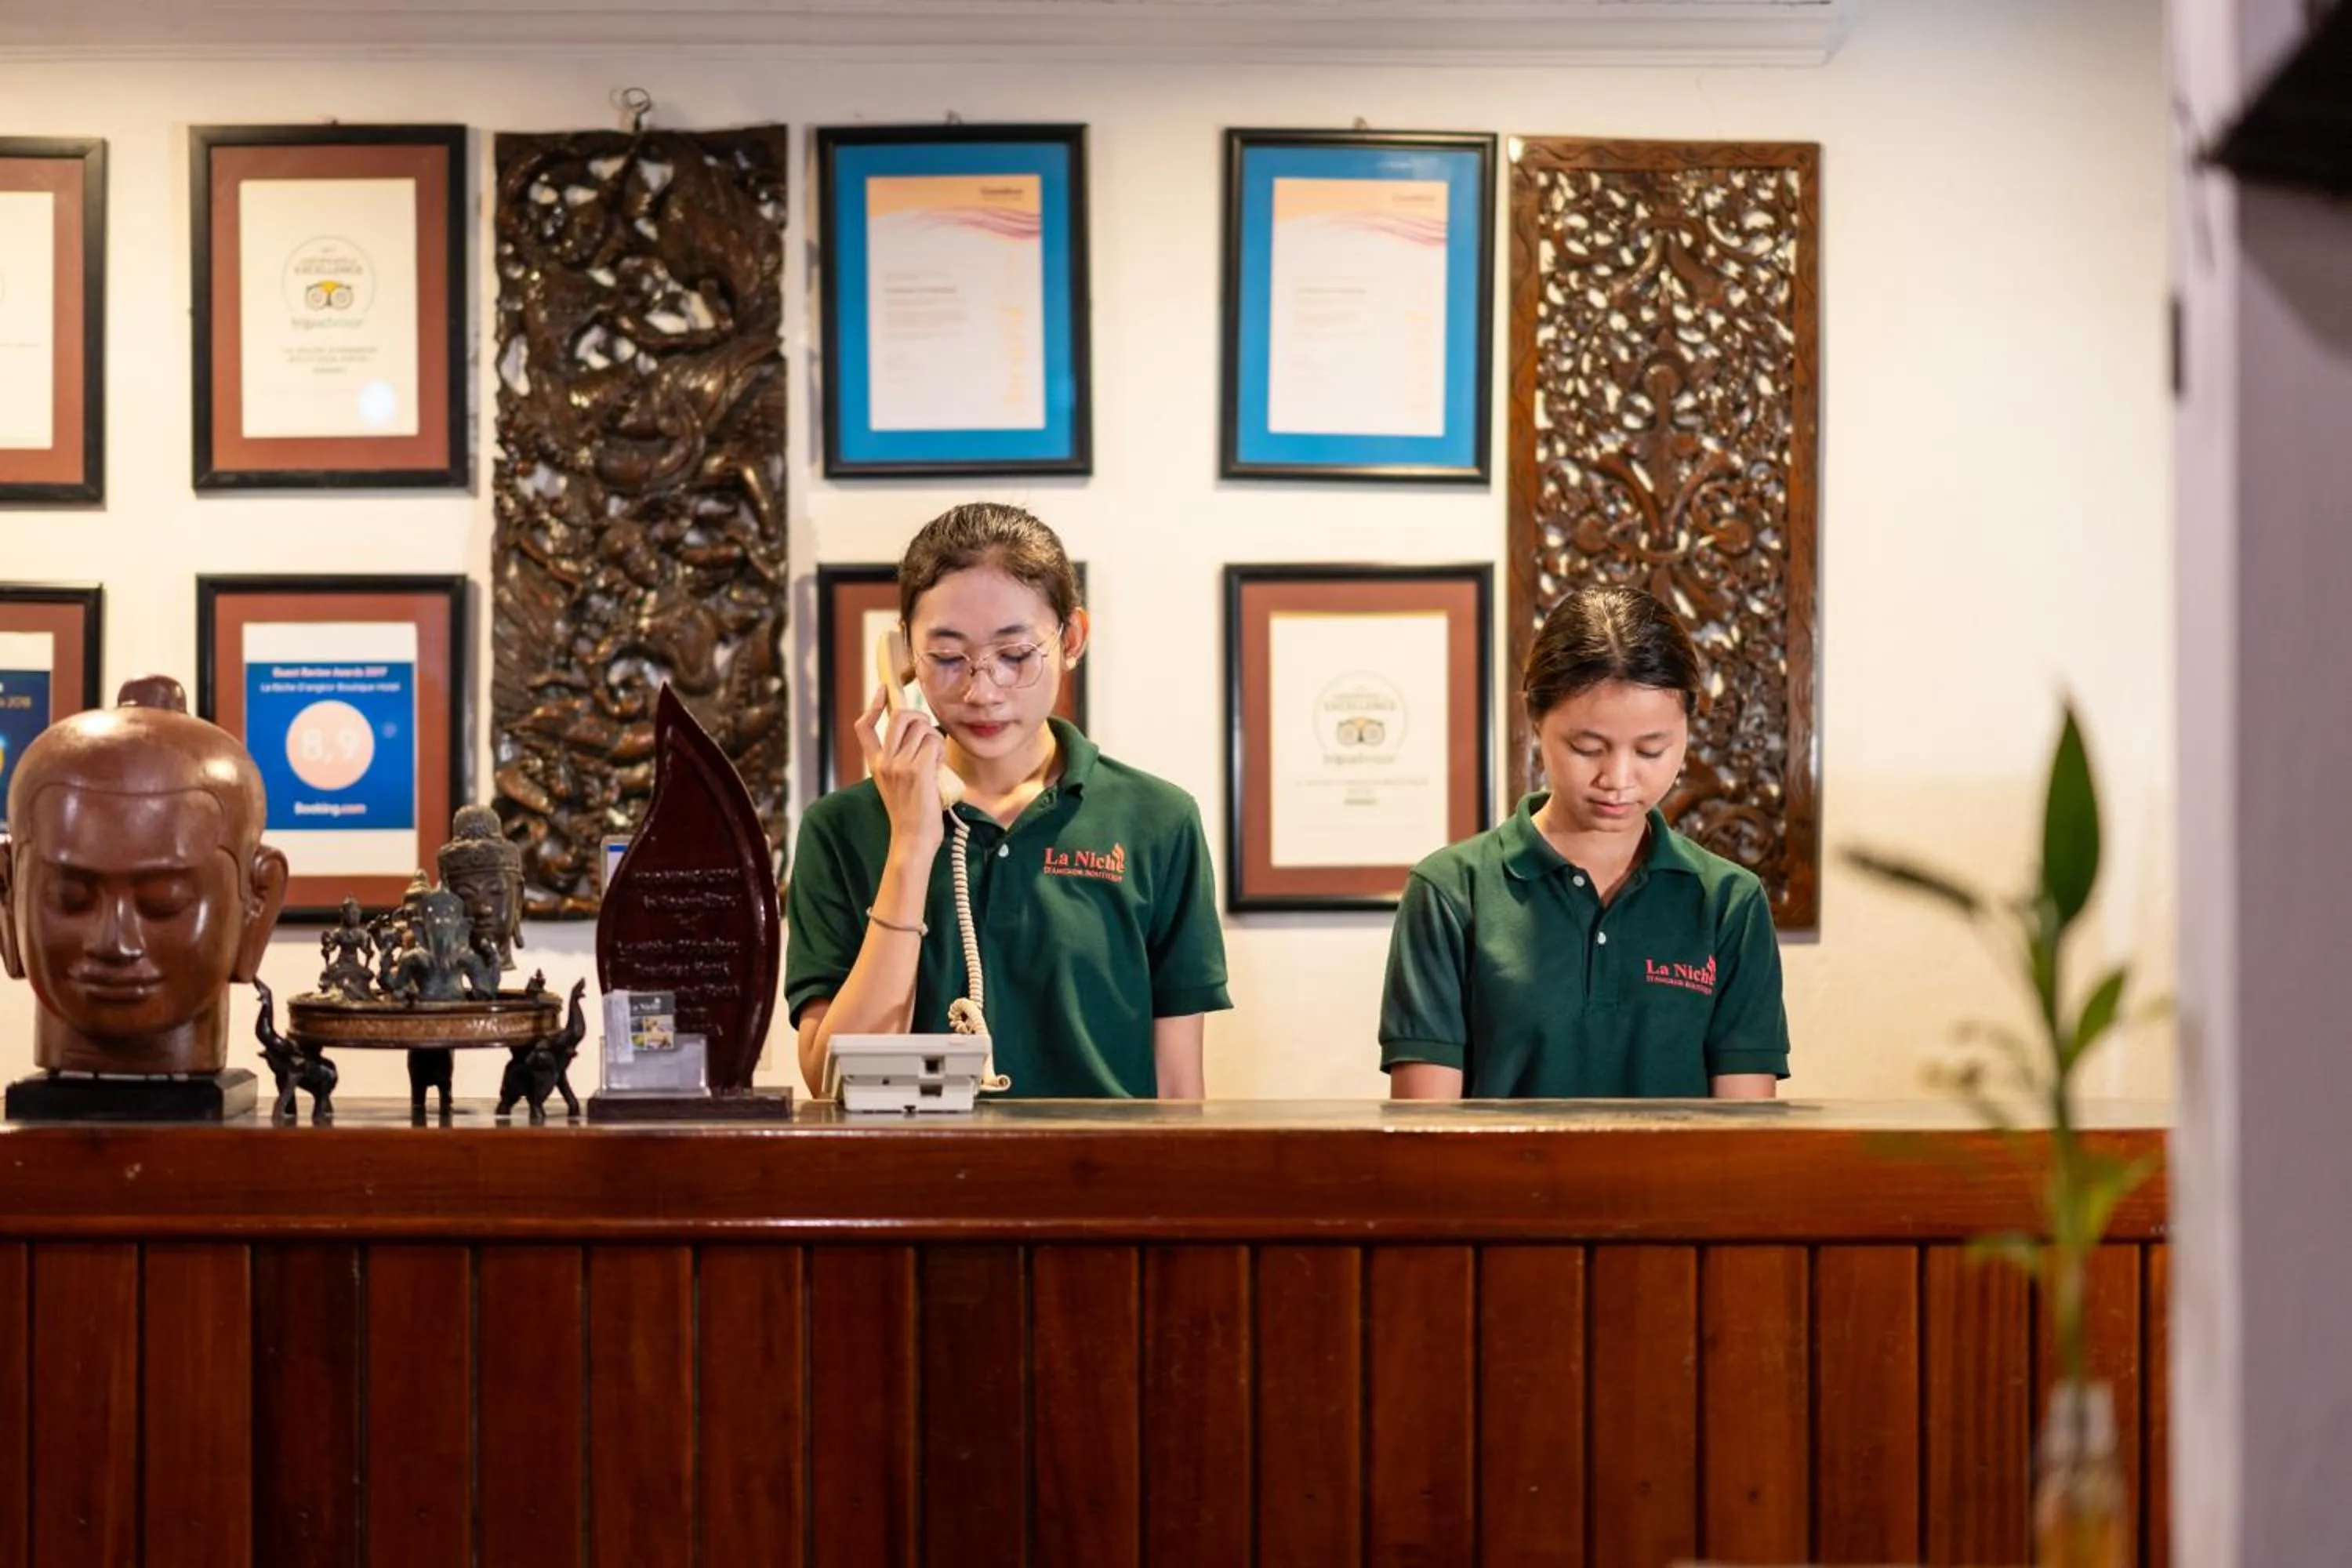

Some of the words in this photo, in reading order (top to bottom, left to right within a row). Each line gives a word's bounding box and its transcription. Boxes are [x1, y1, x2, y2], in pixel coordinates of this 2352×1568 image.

[294, 800, 368, 817] Booking.com
[1044, 848, 1069, 866] La
[1075, 847, 1125, 873] Niche
[1646, 959, 1669, 975] La
[1673, 959, 1716, 985] Niche
